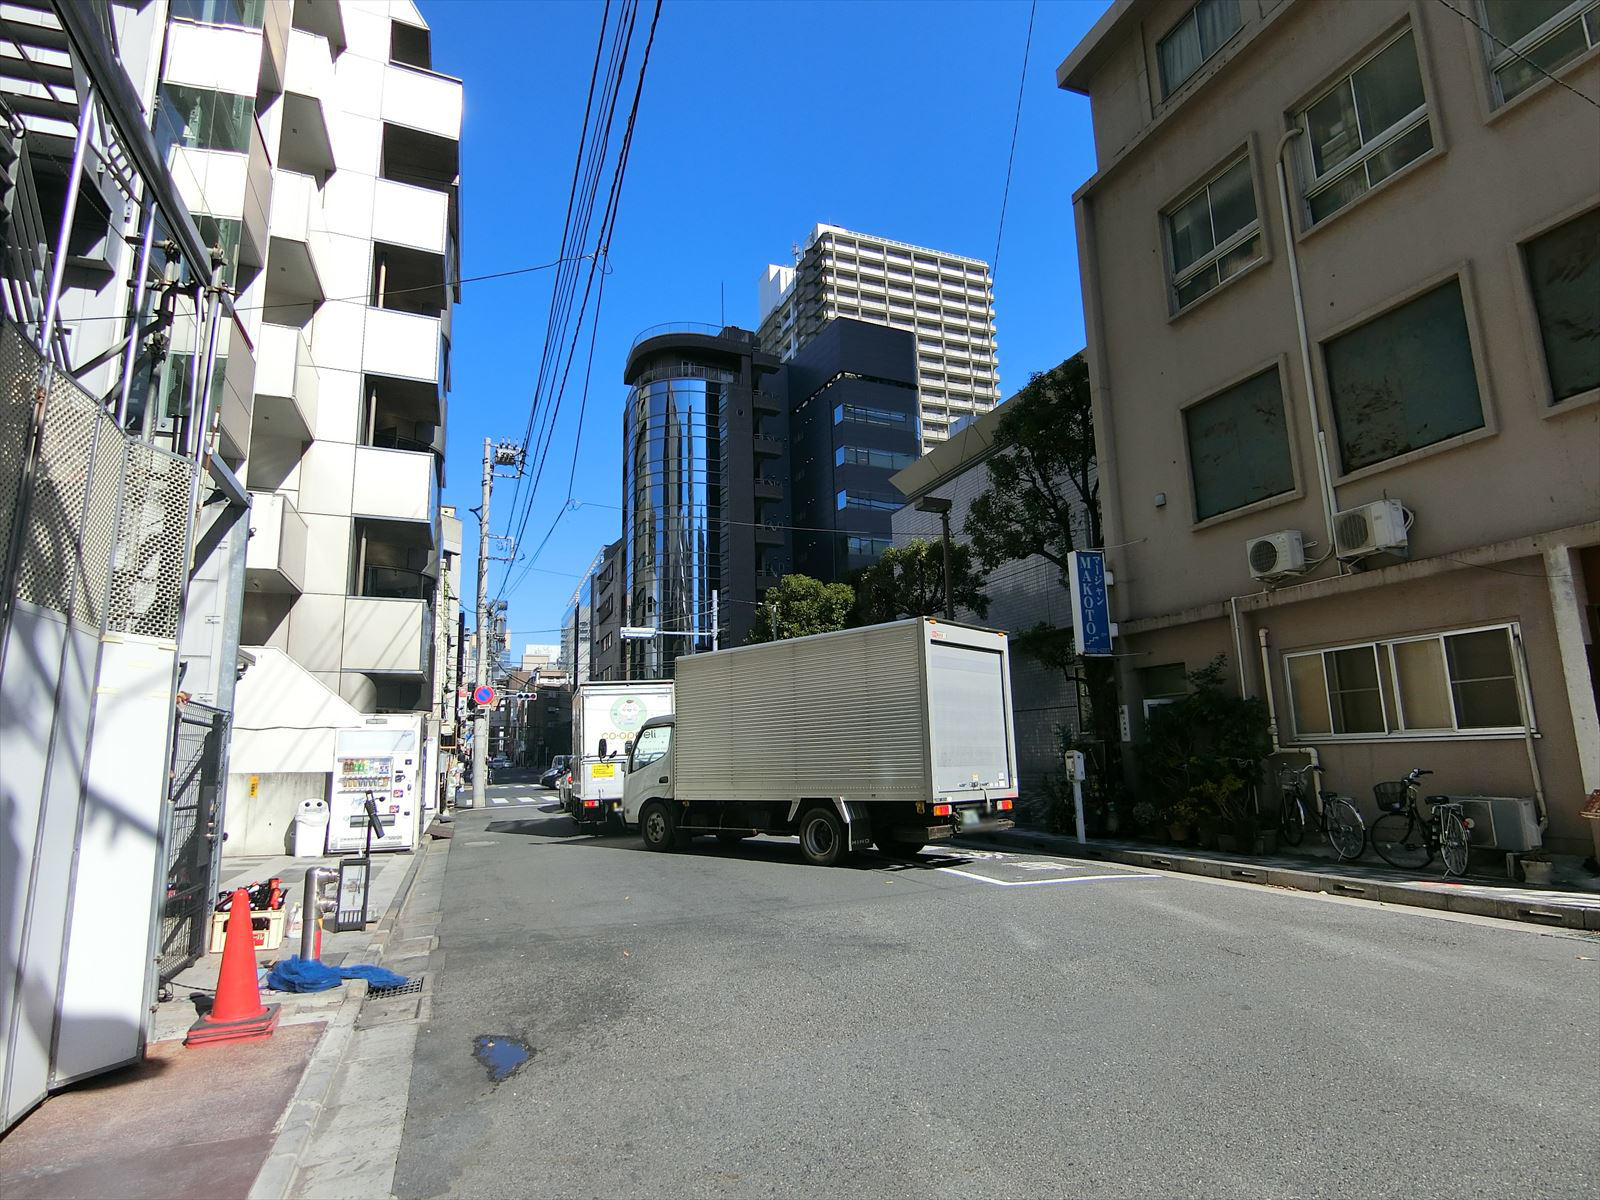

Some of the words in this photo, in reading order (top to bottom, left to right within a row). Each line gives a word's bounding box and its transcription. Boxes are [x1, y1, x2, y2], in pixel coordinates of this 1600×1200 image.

[1080, 557, 1096, 634] MAKOTO
[1092, 556, 1104, 605] マージャン
